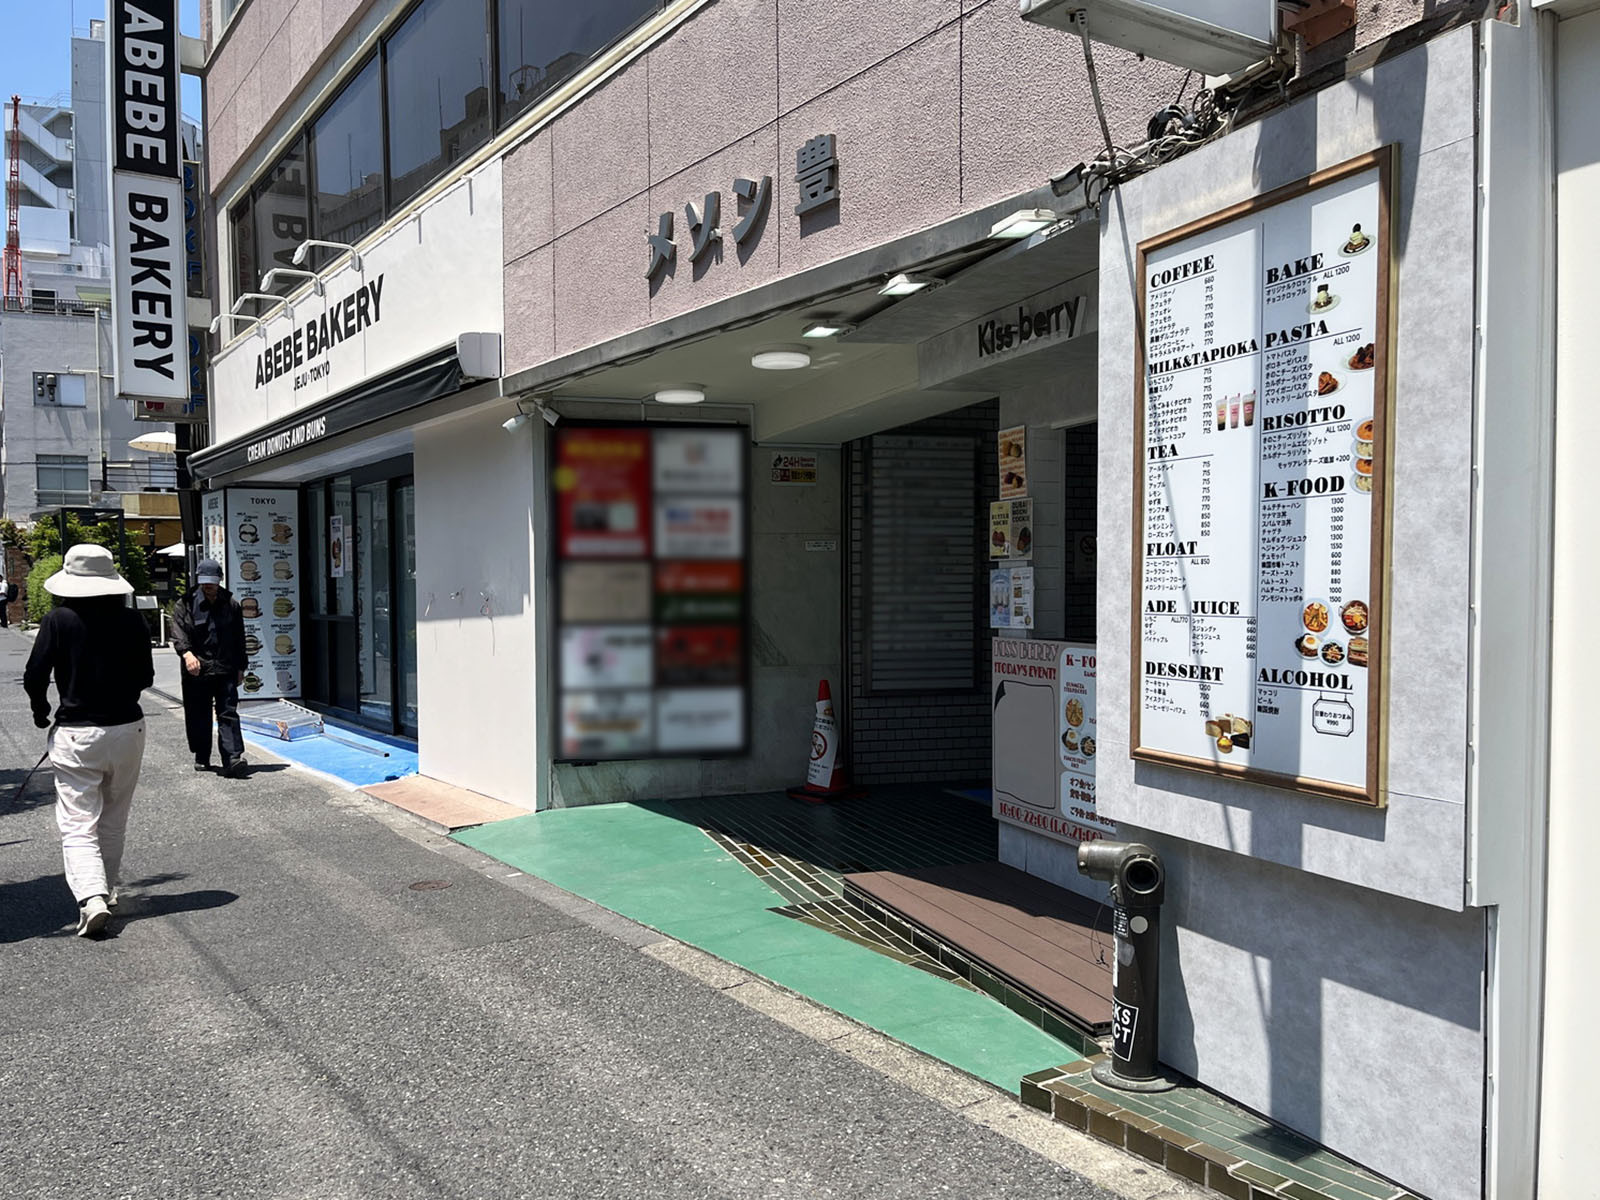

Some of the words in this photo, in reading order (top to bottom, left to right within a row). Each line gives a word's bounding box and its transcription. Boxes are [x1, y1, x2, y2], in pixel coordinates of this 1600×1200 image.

[124, 1, 167, 165] ABEBE
[1151, 255, 1214, 288] COFFEE
[1266, 253, 1323, 284] BAKE
[1323, 270, 1333, 279] ALL
[1336, 266, 1349, 275] 1200
[128, 192, 175, 380] BAKERY
[1205, 303, 1213, 311] 770
[1205, 312, 1213, 320] 770
[255, 327, 303, 390] ABEBE
[306, 273, 385, 362] BAKERY
[1265, 320, 1329, 348] PASTA
[1334, 337, 1344, 345] ALL
[1346, 334, 1360, 342] 1200
[1149, 339, 1258, 376] MILK&TAPIOKA
[310, 360, 330, 383] TOKYO
[1263, 405, 1345, 431] RISOTTO
[1337, 424, 1350, 432] 1200
[291, 424, 305, 447] AND
[1148, 444, 1178, 459] TEA
[1264, 476, 1344, 498] K-FOOD
[250, 497, 276, 505] TOKYO
[1147, 541, 1197, 556] FLOAT
[1145, 600, 1176, 612] ADE
[1192, 601, 1239, 615] JUICE
[1145, 661, 1223, 681] DESSERT
[1258, 668, 1353, 690] ALCOHOL
